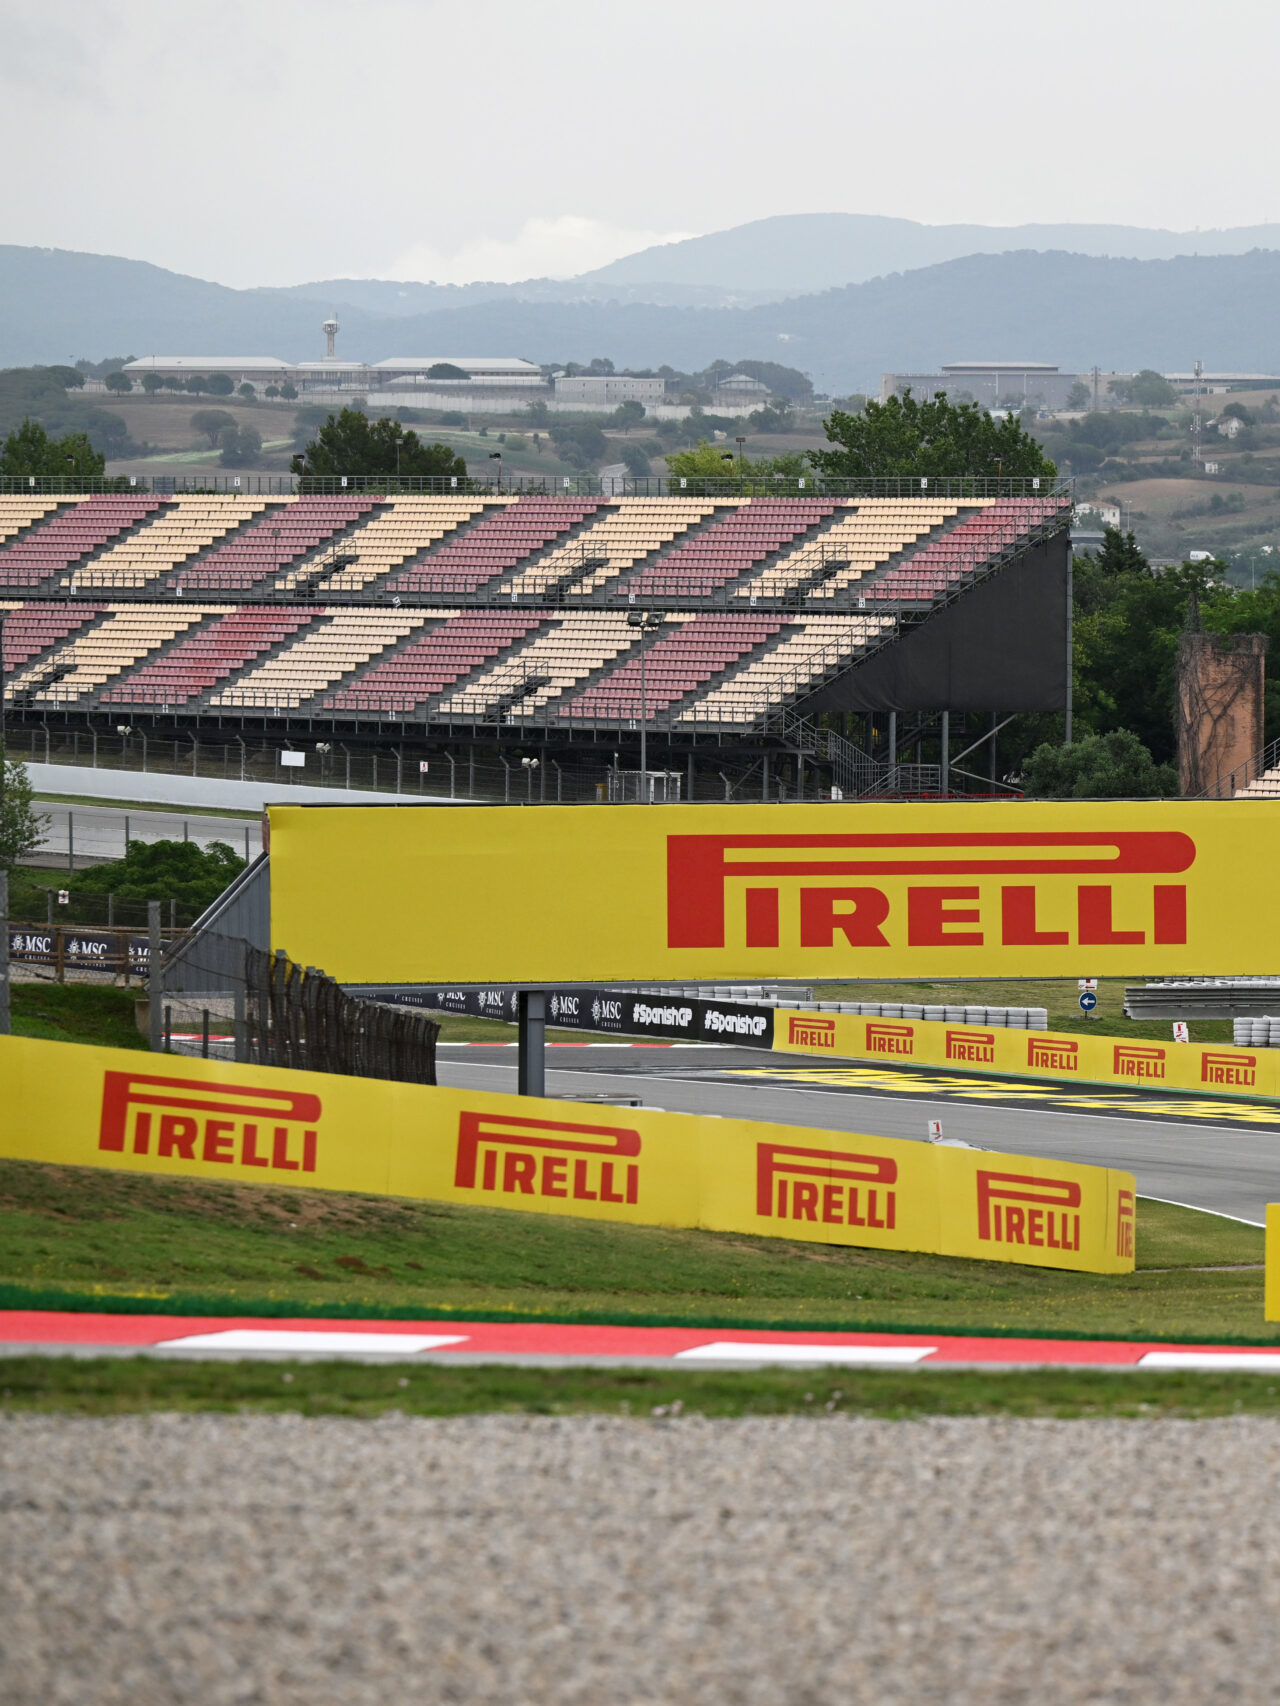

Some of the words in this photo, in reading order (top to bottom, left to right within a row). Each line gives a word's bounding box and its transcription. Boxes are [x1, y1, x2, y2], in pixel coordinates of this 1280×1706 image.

[667, 831, 1197, 948] PIRELLI
[26, 936, 51, 953] MSC
[81, 941, 108, 960] MSC
[487, 991, 505, 1007] MSC
[560, 995, 580, 1015] MSC
[601, 1000, 622, 1020] MSC
[633, 1003, 693, 1027] #SpanishGP
[704, 1009, 767, 1036] #SpanishGP
[789, 1017, 836, 1048] PIRELLI
[866, 1024, 914, 1054] PIRELLI
[946, 1030, 995, 1063] PIRELLI
[1028, 1037, 1079, 1071] PIRELLI
[1113, 1045, 1166, 1078] PIRELLI
[1201, 1052, 1257, 1086] PIRELLI
[98, 1070, 322, 1172] PIRELLI
[454, 1110, 642, 1204] PIRELLI
[756, 1142, 898, 1230] PIRELLI
[976, 1169, 1082, 1251] PIRELLI
